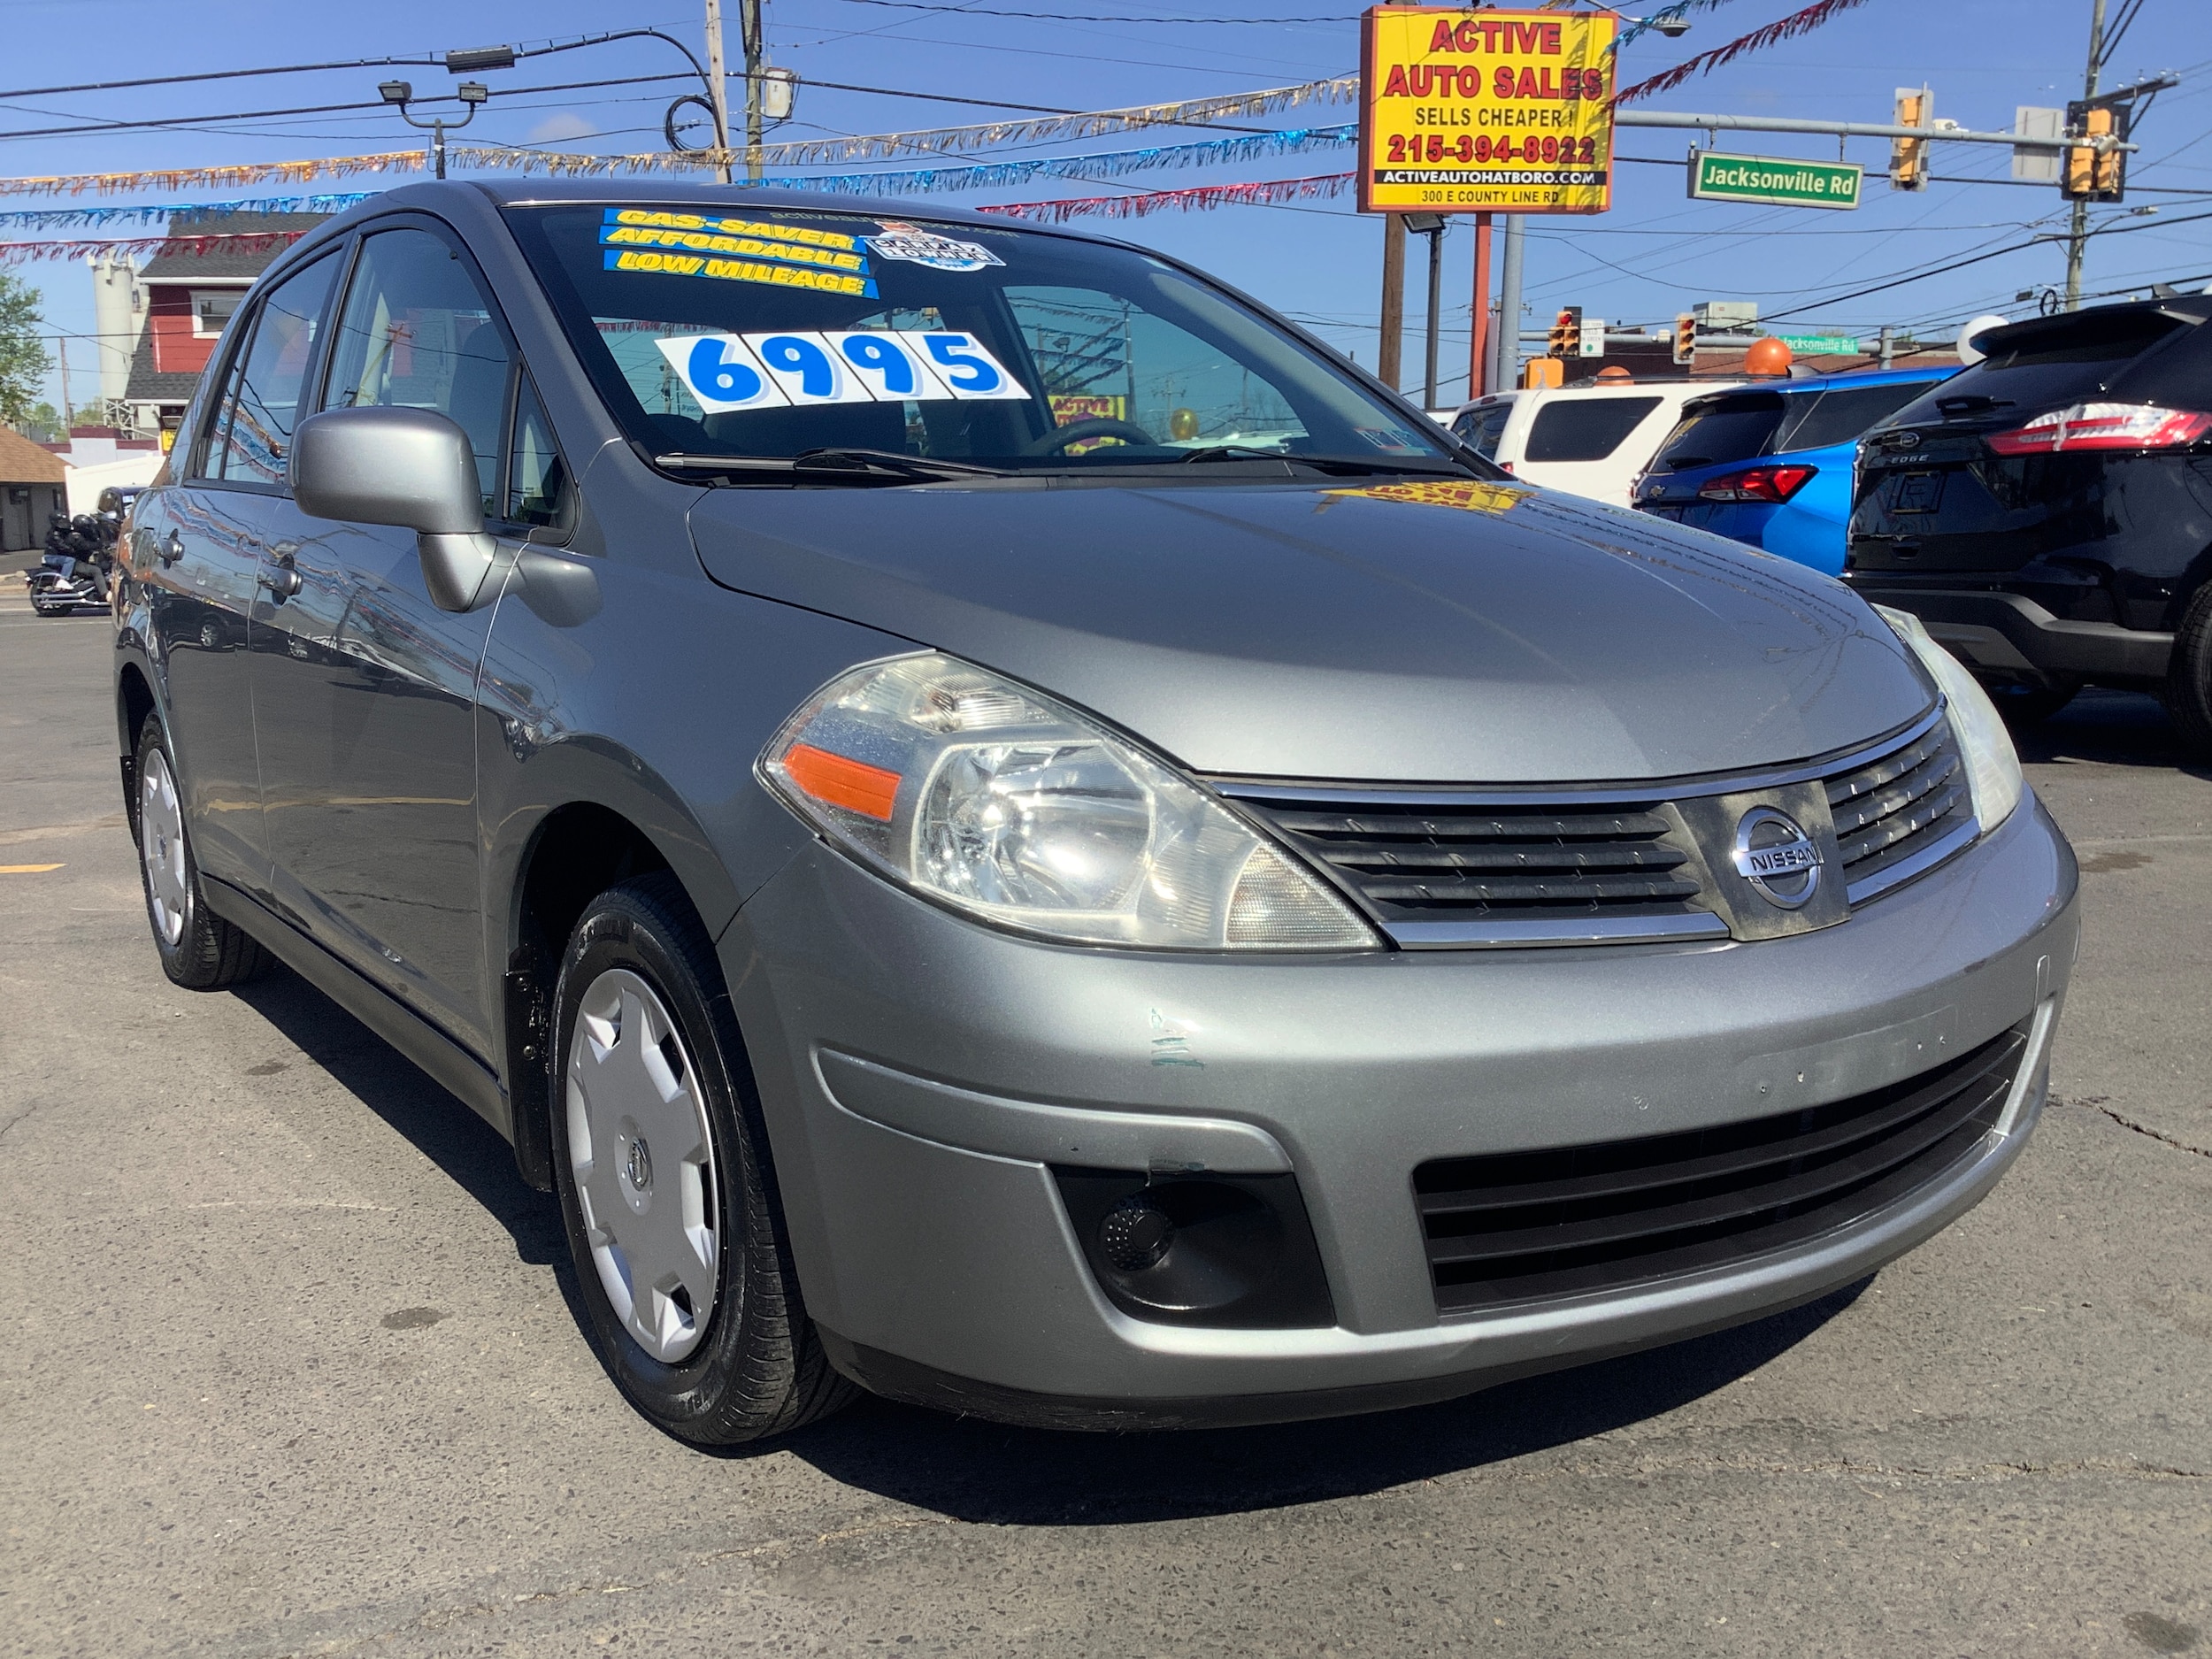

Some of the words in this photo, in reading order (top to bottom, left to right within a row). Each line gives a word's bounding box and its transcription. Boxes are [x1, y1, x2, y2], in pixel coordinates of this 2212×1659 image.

[1429, 19, 1562, 55] ACTIVE
[1383, 64, 1481, 98] AUTO
[1493, 65, 1603, 101] SALES
[1415, 107, 1471, 127] SELLS
[1478, 108, 1562, 128] CHEAPER
[1386, 134, 1596, 165] 215-394-8922
[1383, 171, 1595, 185] ACTIVEAUTOHATBORO.COM
[1704, 165, 1825, 194] Jacksonville
[1829, 175, 1855, 196] Rd
[1421, 190, 1443, 203] 300
[1447, 191, 1454, 203] E
[1457, 190, 1507, 203] COUNTY
[1512, 191, 1540, 203] LINE
[1543, 191, 1559, 204] RD
[617, 210, 856, 250] GAS-SAVER
[606, 227, 863, 270] AFFORDABLE
[617, 252, 705, 274] LOW
[704, 259, 865, 295] MILEAGE
[1841, 339, 1855, 352] Rd
[688, 334, 1005, 403] 6995
[1053, 397, 1110, 412] ACTIVE
[1891, 454, 1930, 465] EDGE
[1749, 845, 1818, 872] NISSAN
